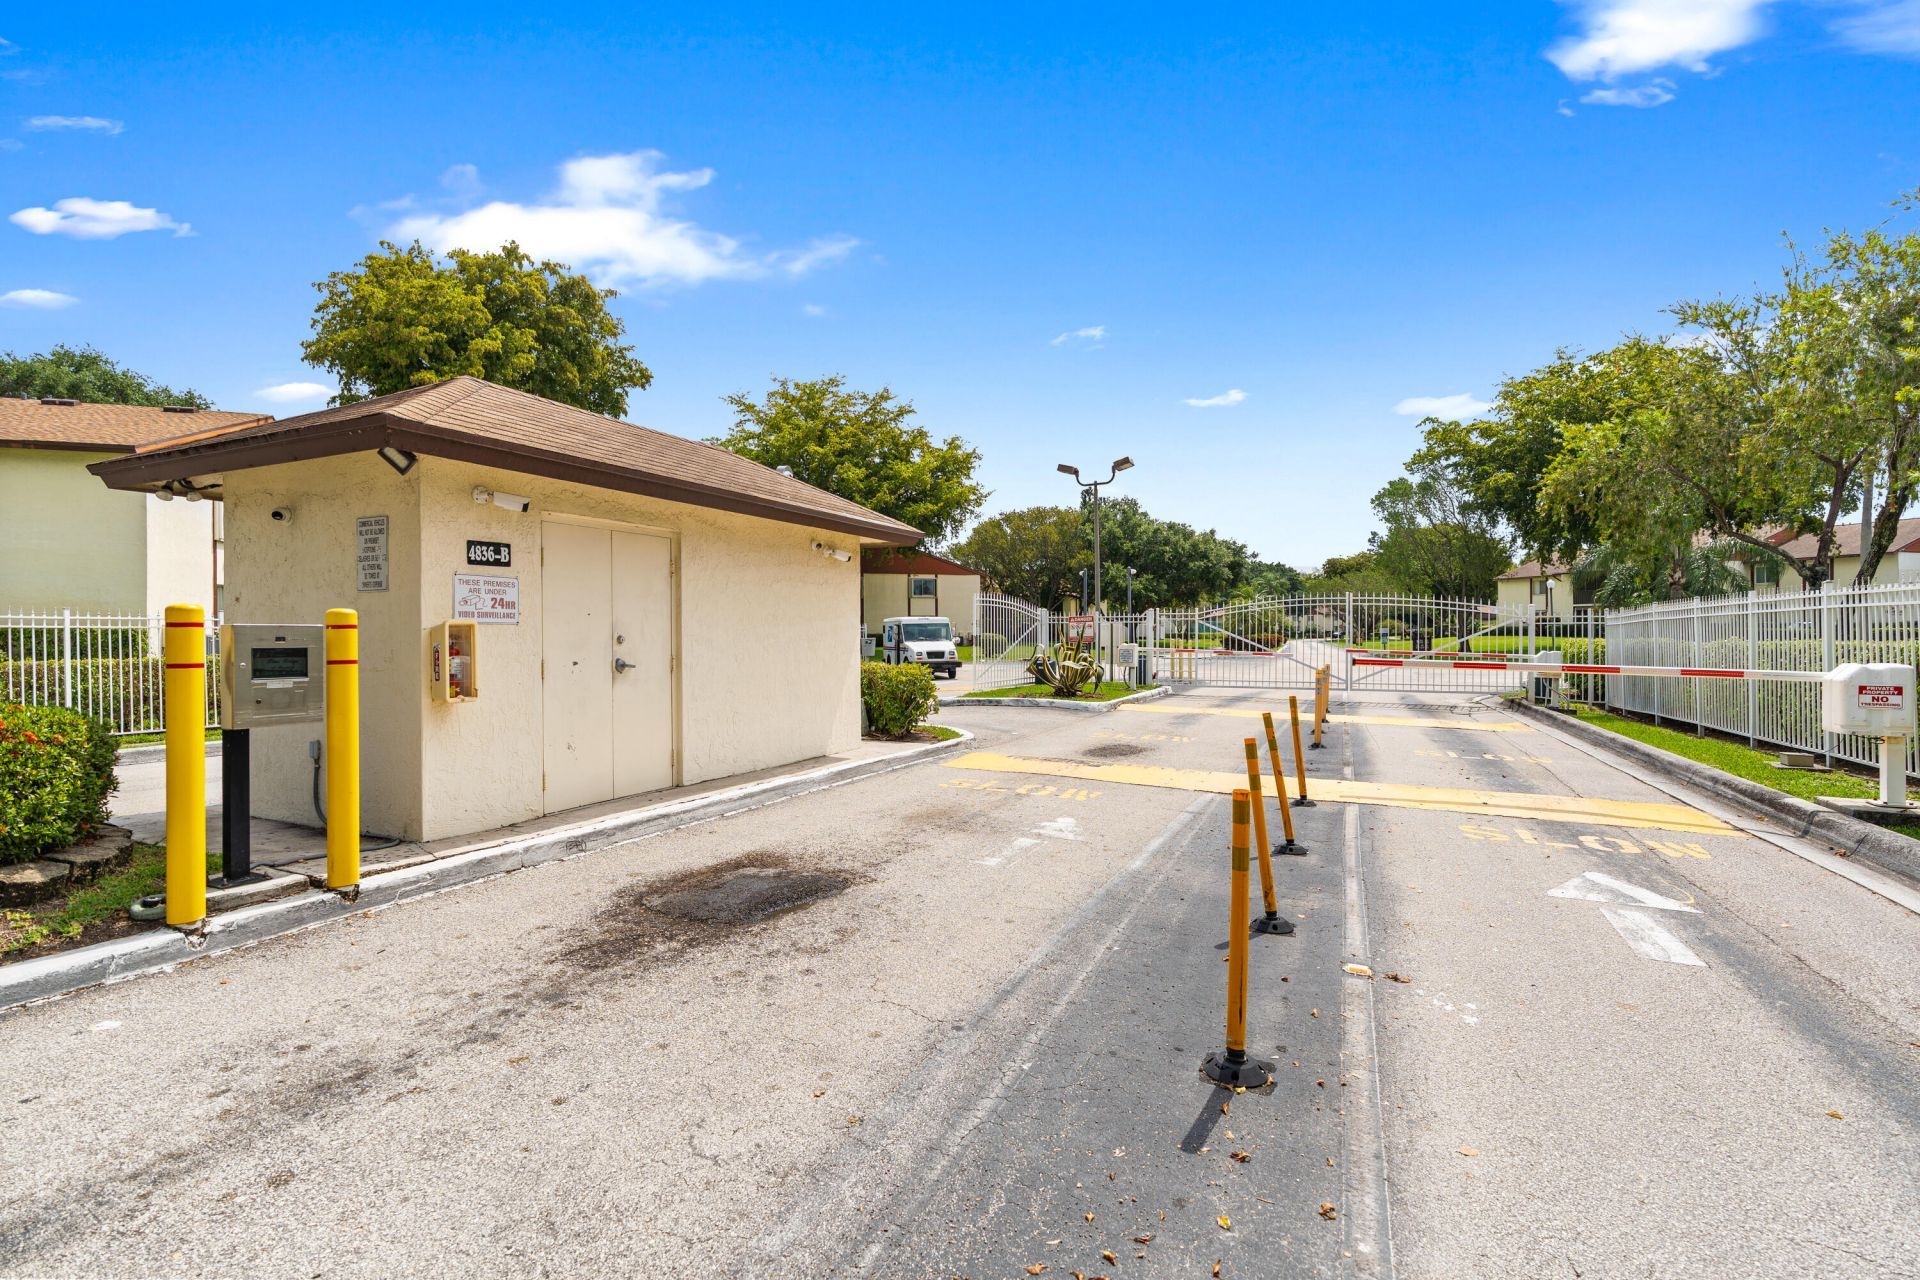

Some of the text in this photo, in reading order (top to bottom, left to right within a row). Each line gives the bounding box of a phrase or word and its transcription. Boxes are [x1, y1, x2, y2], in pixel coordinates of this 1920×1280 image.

[468, 545, 510, 563] 4836-B
[483, 580, 516, 588] PREMISES
[458, 610, 516, 619] VIDEO SURVEILLANCE
[938, 778, 1104, 801] SLOW
[1458, 825, 1712, 859] SLOW
